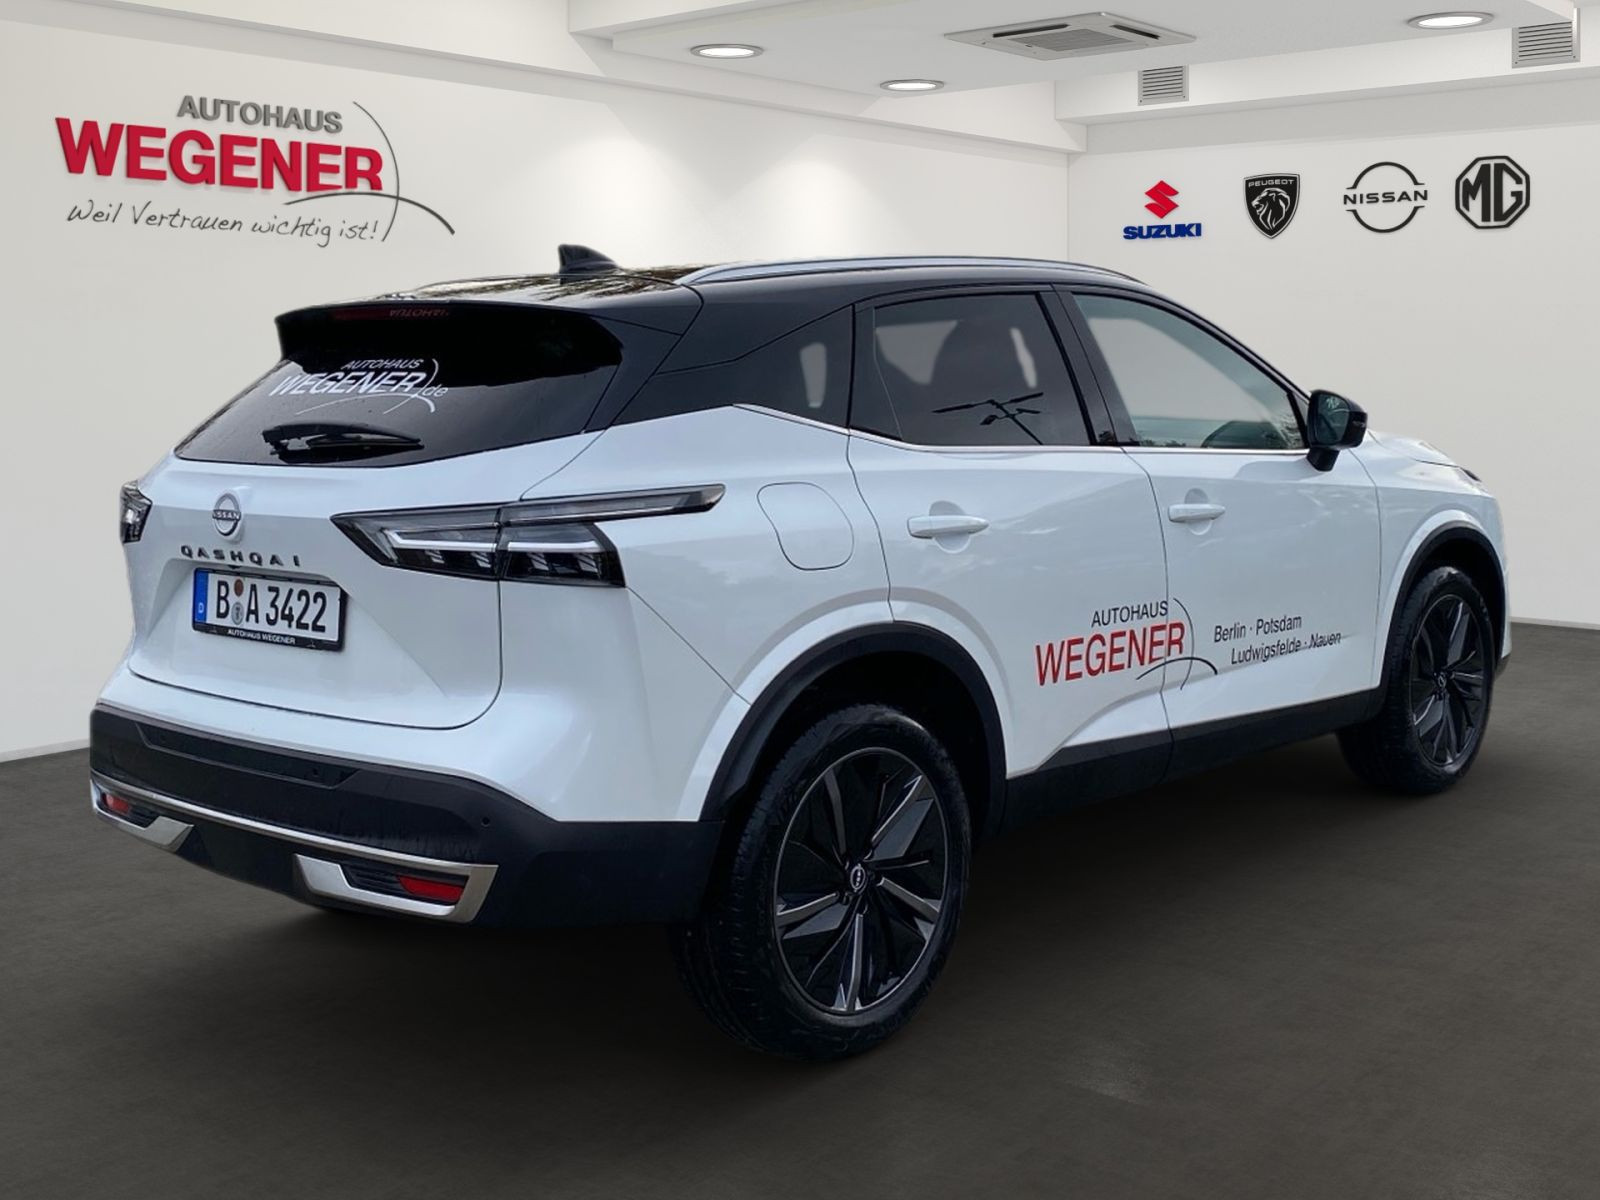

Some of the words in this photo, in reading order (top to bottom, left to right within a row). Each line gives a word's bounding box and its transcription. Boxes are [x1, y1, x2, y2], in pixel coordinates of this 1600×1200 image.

[176, 95, 343, 133] AUTOHAUS
[55, 117, 384, 193] WEGENER
[1248, 178, 1295, 188] PEUGEOT
[1461, 163, 1523, 223] MG
[1343, 189, 1428, 206] NISSAN
[67, 199, 122, 223] Weil
[131, 200, 243, 233] Vertrauen
[251, 214, 332, 248] wichtig
[339, 217, 378, 241] ist!
[1123, 223, 1202, 240] SUZUKI
[340, 358, 424, 370] AUTOHAUS
[269, 371, 427, 396] WEGENER
[180, 544, 301, 567] QASHQAI
[216, 580, 230, 619] B
[246, 583, 260, 624] A
[265, 585, 327, 633] 3422
[1091, 600, 1168, 627] AUTOHAUS
[227, 628, 261, 641] AUTOHAUS
[262, 632, 296, 645] WEGENER
[1213, 622, 1247, 643] Berlin
[1255, 613, 1302, 635] Potsdam
[1035, 620, 1185, 687] WEGENER
[1231, 639, 1302, 665] Ludwigsfelde
[1309, 632, 1341, 650] Nauen
